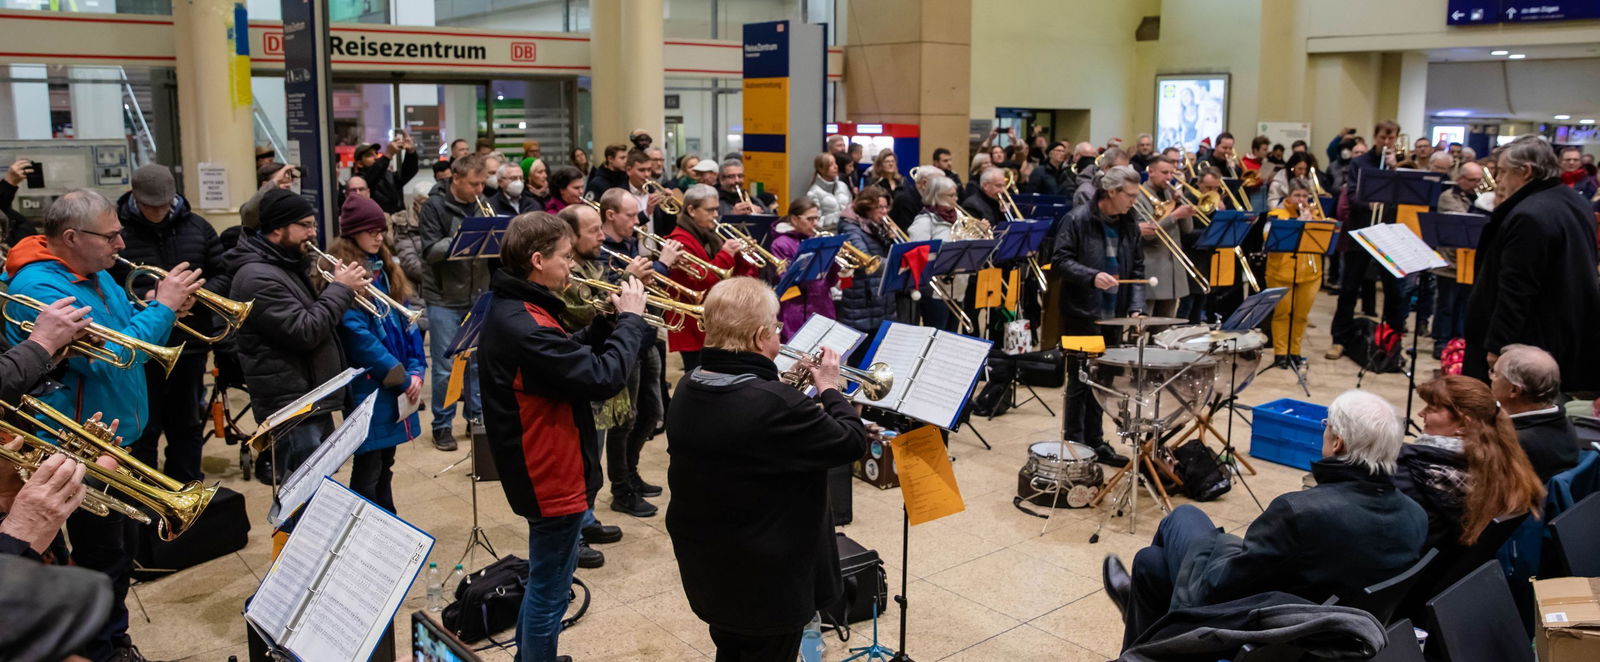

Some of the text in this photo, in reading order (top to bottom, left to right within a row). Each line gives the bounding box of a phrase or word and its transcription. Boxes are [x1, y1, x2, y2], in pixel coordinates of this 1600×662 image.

[329, 35, 487, 60] Reisezentrum
[513, 44, 535, 60] DB
[22, 199, 40, 209] Du
